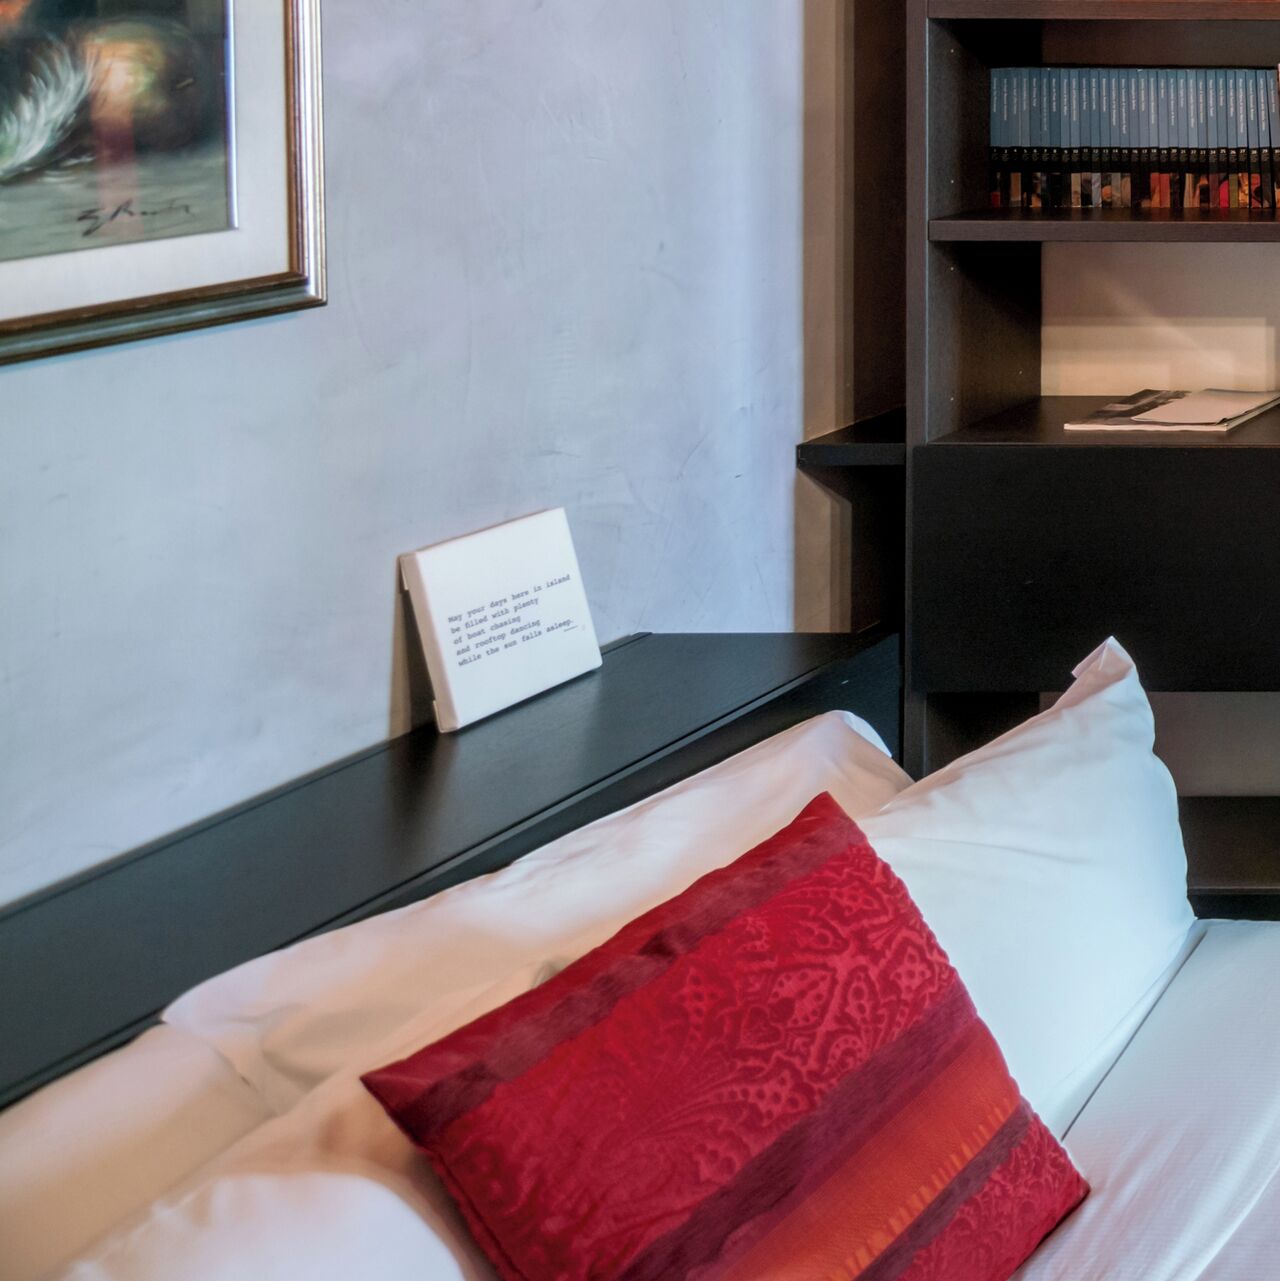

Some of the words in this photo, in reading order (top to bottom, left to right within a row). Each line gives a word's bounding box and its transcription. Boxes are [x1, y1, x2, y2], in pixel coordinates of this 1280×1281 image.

[448, 614, 462, 623] May
[467, 606, 485, 618] your
[490, 598, 507, 608] days
[511, 590, 529, 600] here
[546, 574, 570, 588] island
[451, 626, 460, 634] be
[465, 615, 488, 629] filled
[492, 608, 509, 619] with
[514, 598, 538, 613] plenty
[453, 636, 462, 645] of
[490, 616, 521, 631] chasing
[456, 646, 470, 656] and
[475, 632, 506, 649] rooftop
[510, 619, 541, 635] dancing
[458, 653, 481, 666] while
[486, 647, 499, 656] the
[504, 640, 517, 649] sun
[521, 630, 542, 642] falls
